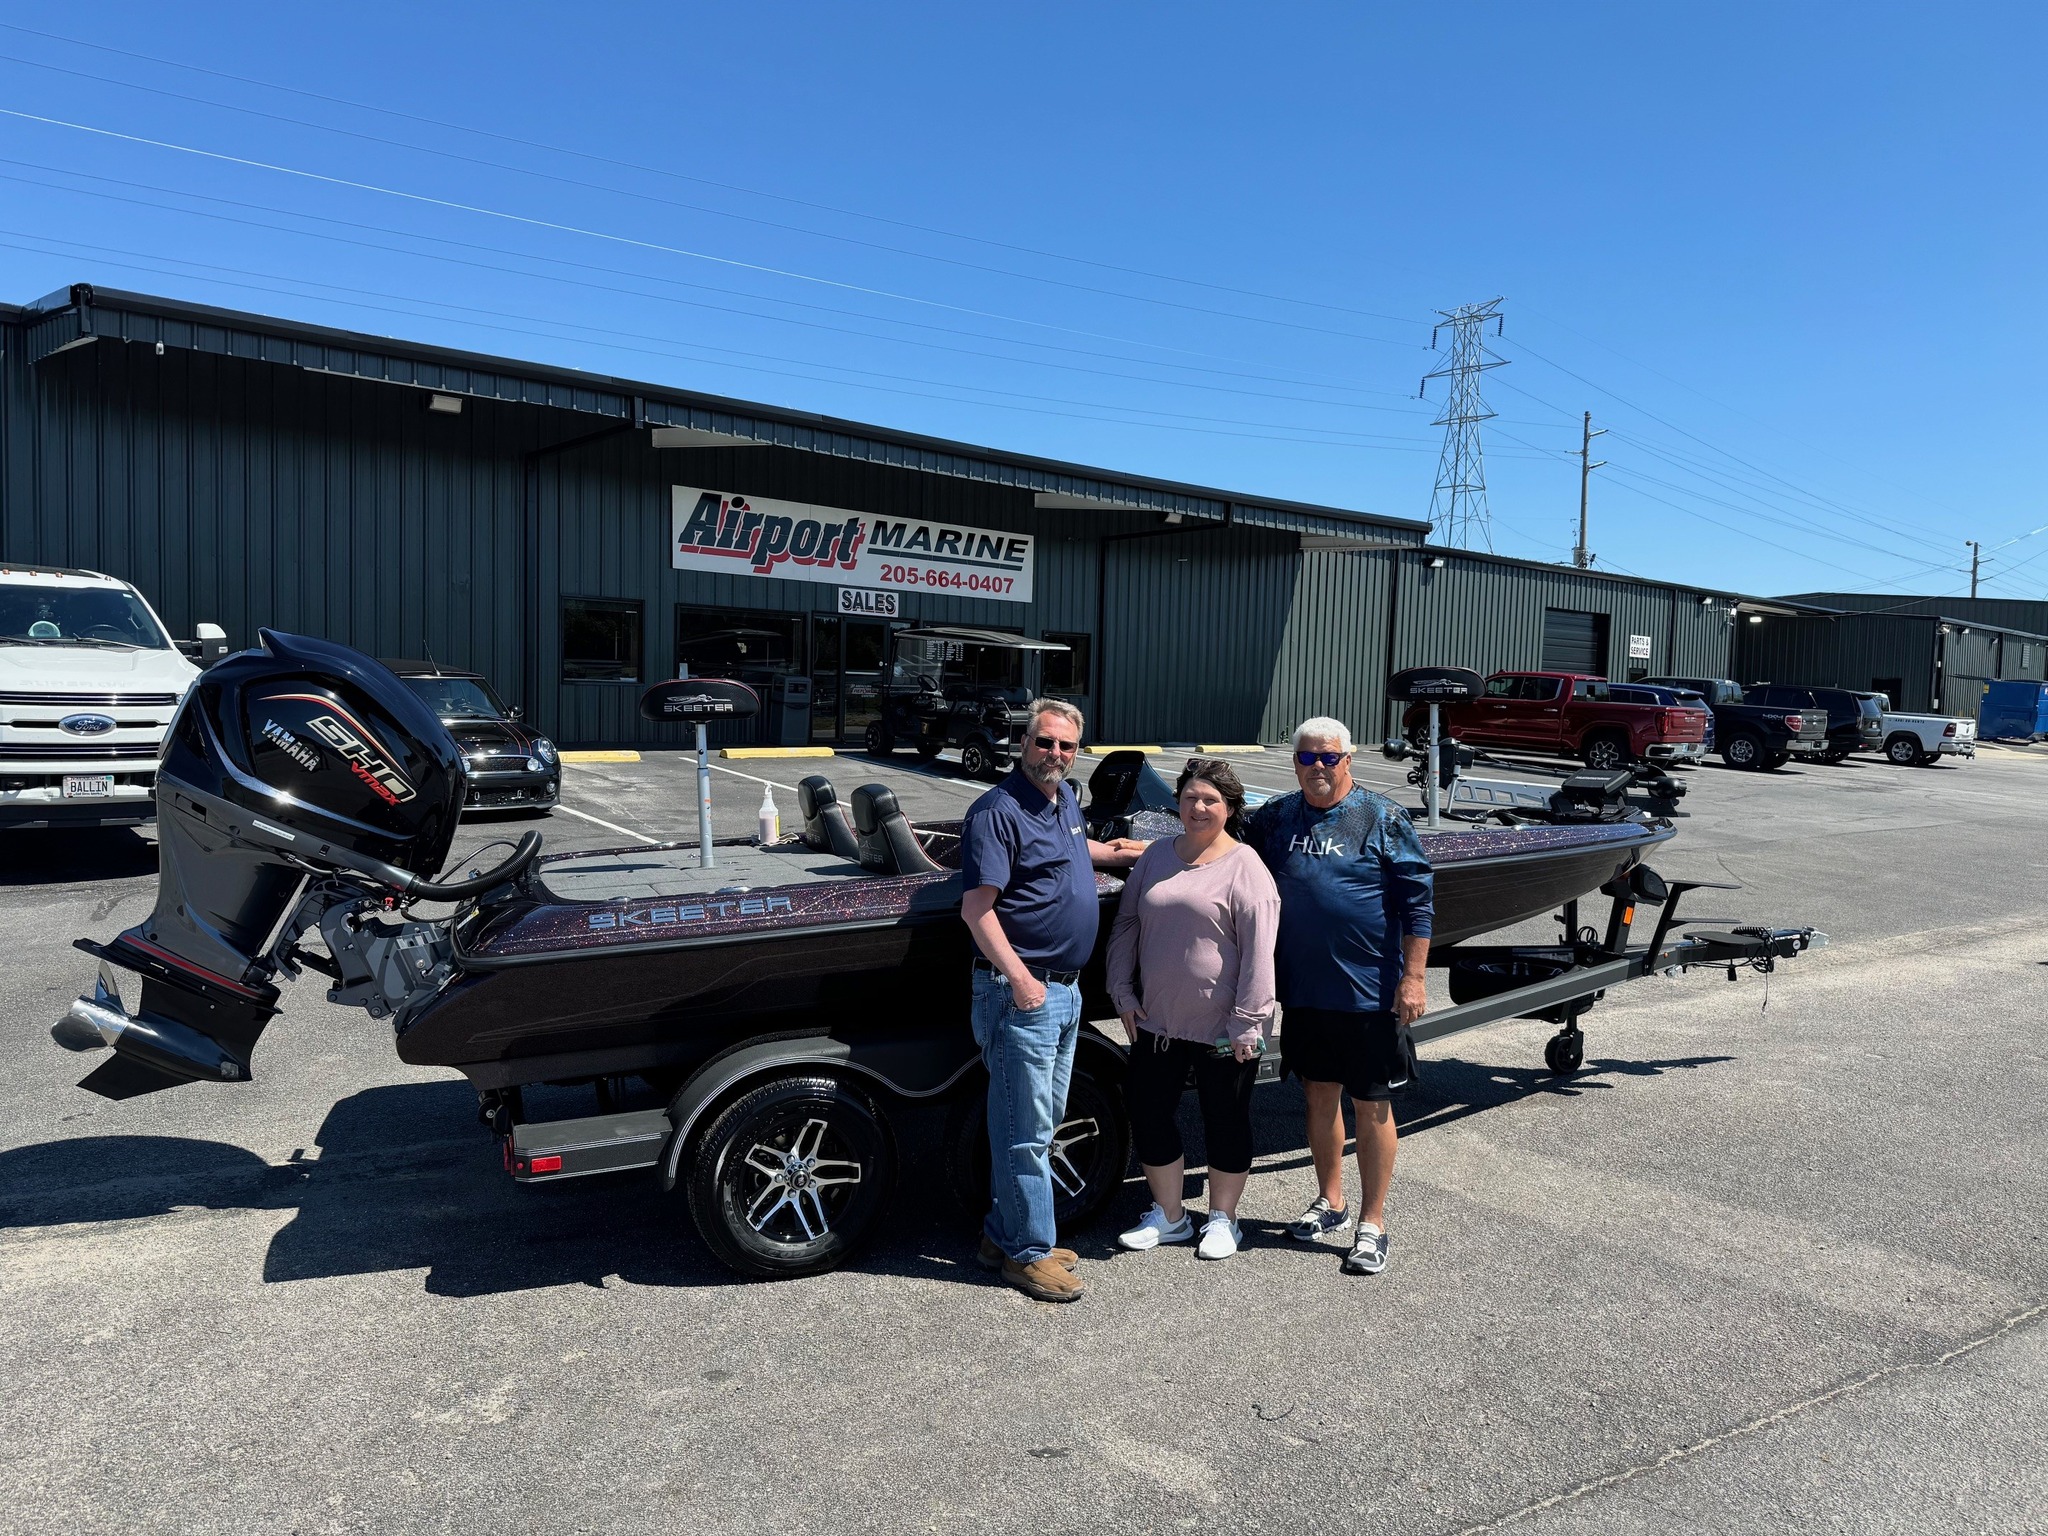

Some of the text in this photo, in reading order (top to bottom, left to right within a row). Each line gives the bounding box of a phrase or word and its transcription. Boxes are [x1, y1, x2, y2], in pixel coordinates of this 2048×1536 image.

[678, 492, 1029, 574] Airport MARINE
[880, 563, 1014, 594] 205-664-0407
[841, 590, 896, 615] SALES
[1631, 636, 1645, 646] PARTS
[1630, 646, 1649, 656] SERVICE
[1409, 687, 1468, 695] SKEETER
[663, 703, 734, 712] SKEETER
[75, 721, 102, 731] Ford
[261, 718, 321, 772] YAMAHA
[306, 716, 417, 803] SHO
[70, 781, 109, 793] BALLIN
[588, 896, 792, 929] SKEETER
